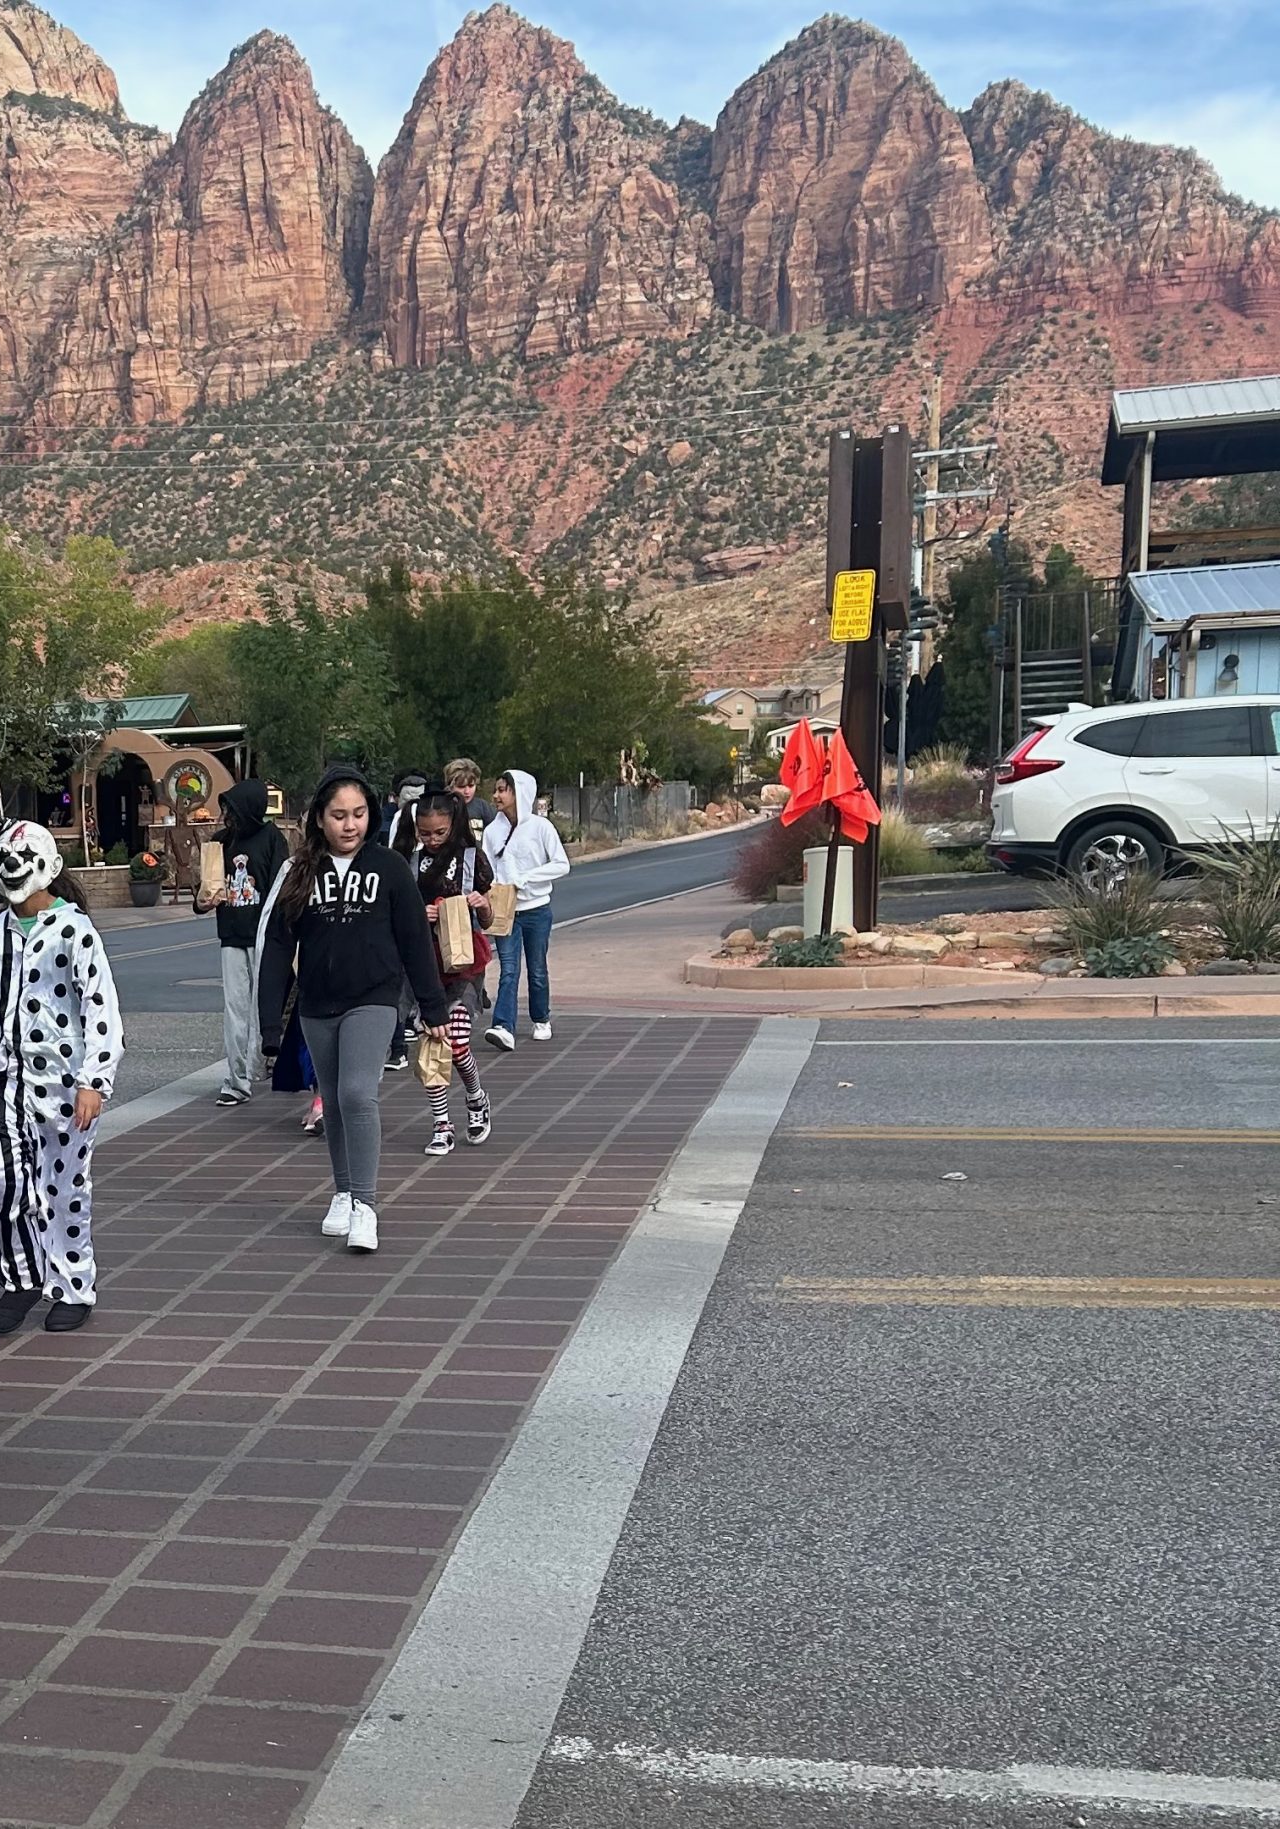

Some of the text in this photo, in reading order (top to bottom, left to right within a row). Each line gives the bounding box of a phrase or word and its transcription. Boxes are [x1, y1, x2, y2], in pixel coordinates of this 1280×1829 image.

[851, 608, 867, 617] FLAG
[848, 618, 868, 626] ADDED
[308, 870, 380, 906] AERO
[342, 903, 362, 915] York
